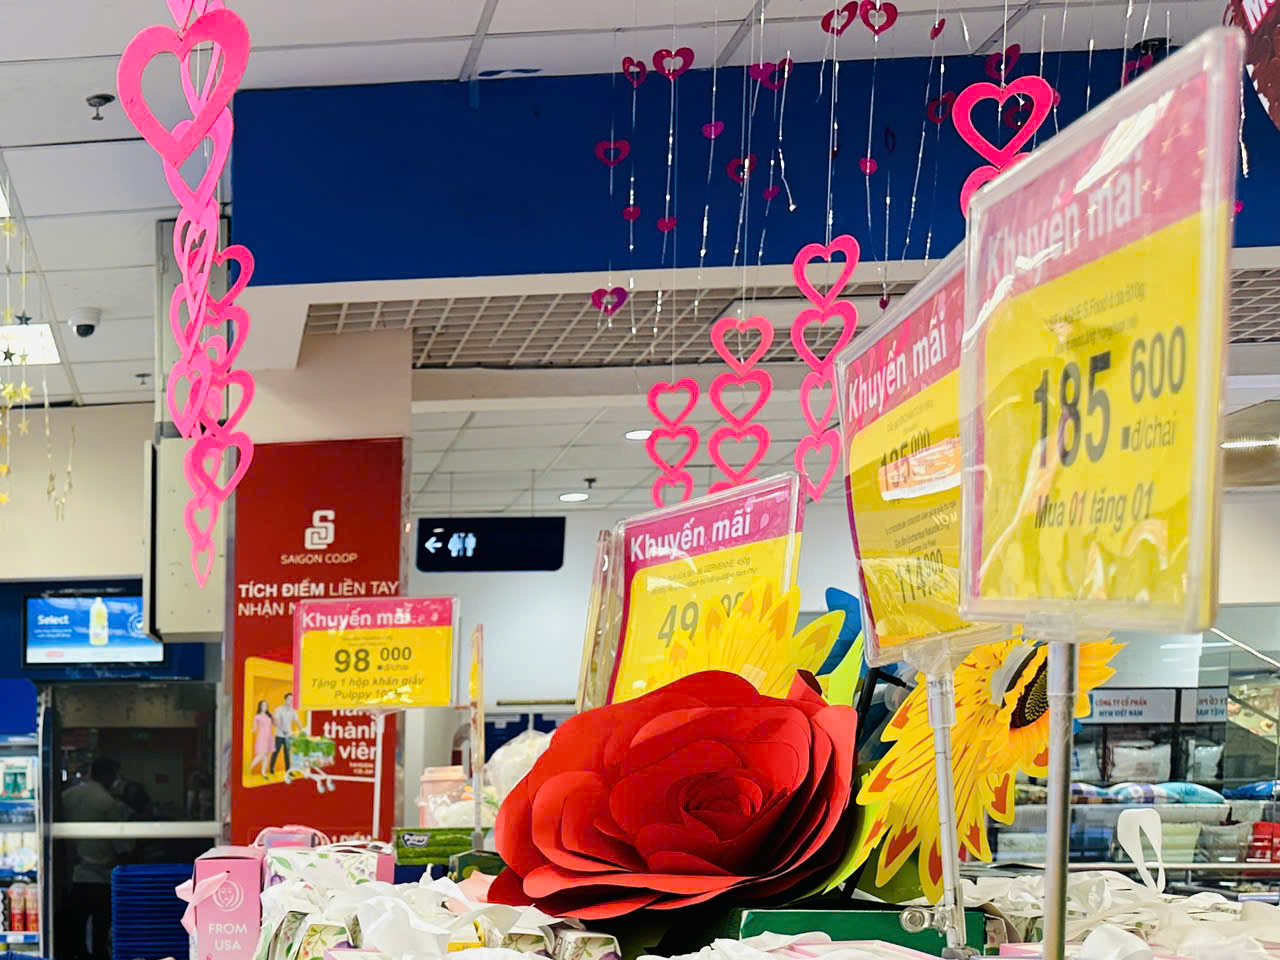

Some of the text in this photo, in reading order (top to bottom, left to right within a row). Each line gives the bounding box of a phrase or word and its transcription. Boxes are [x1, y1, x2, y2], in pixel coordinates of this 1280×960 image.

[847, 340, 906, 423] Khuyến
[912, 310, 948, 376] mãi
[1130, 325, 1187, 404] 600
[1132, 481, 1155, 521] 01
[631, 509, 751, 563] Khuyến mãi
[280, 553, 358, 565] SAIGON COOP
[238, 578, 401, 598] TÍCH ĐIỂM LIỀN TAY
[238, 601, 285, 619] NHẬN
[302, 608, 372, 632] Khuyến
[208, 923, 247, 935] FROM
[214, 938, 240, 951] USA
